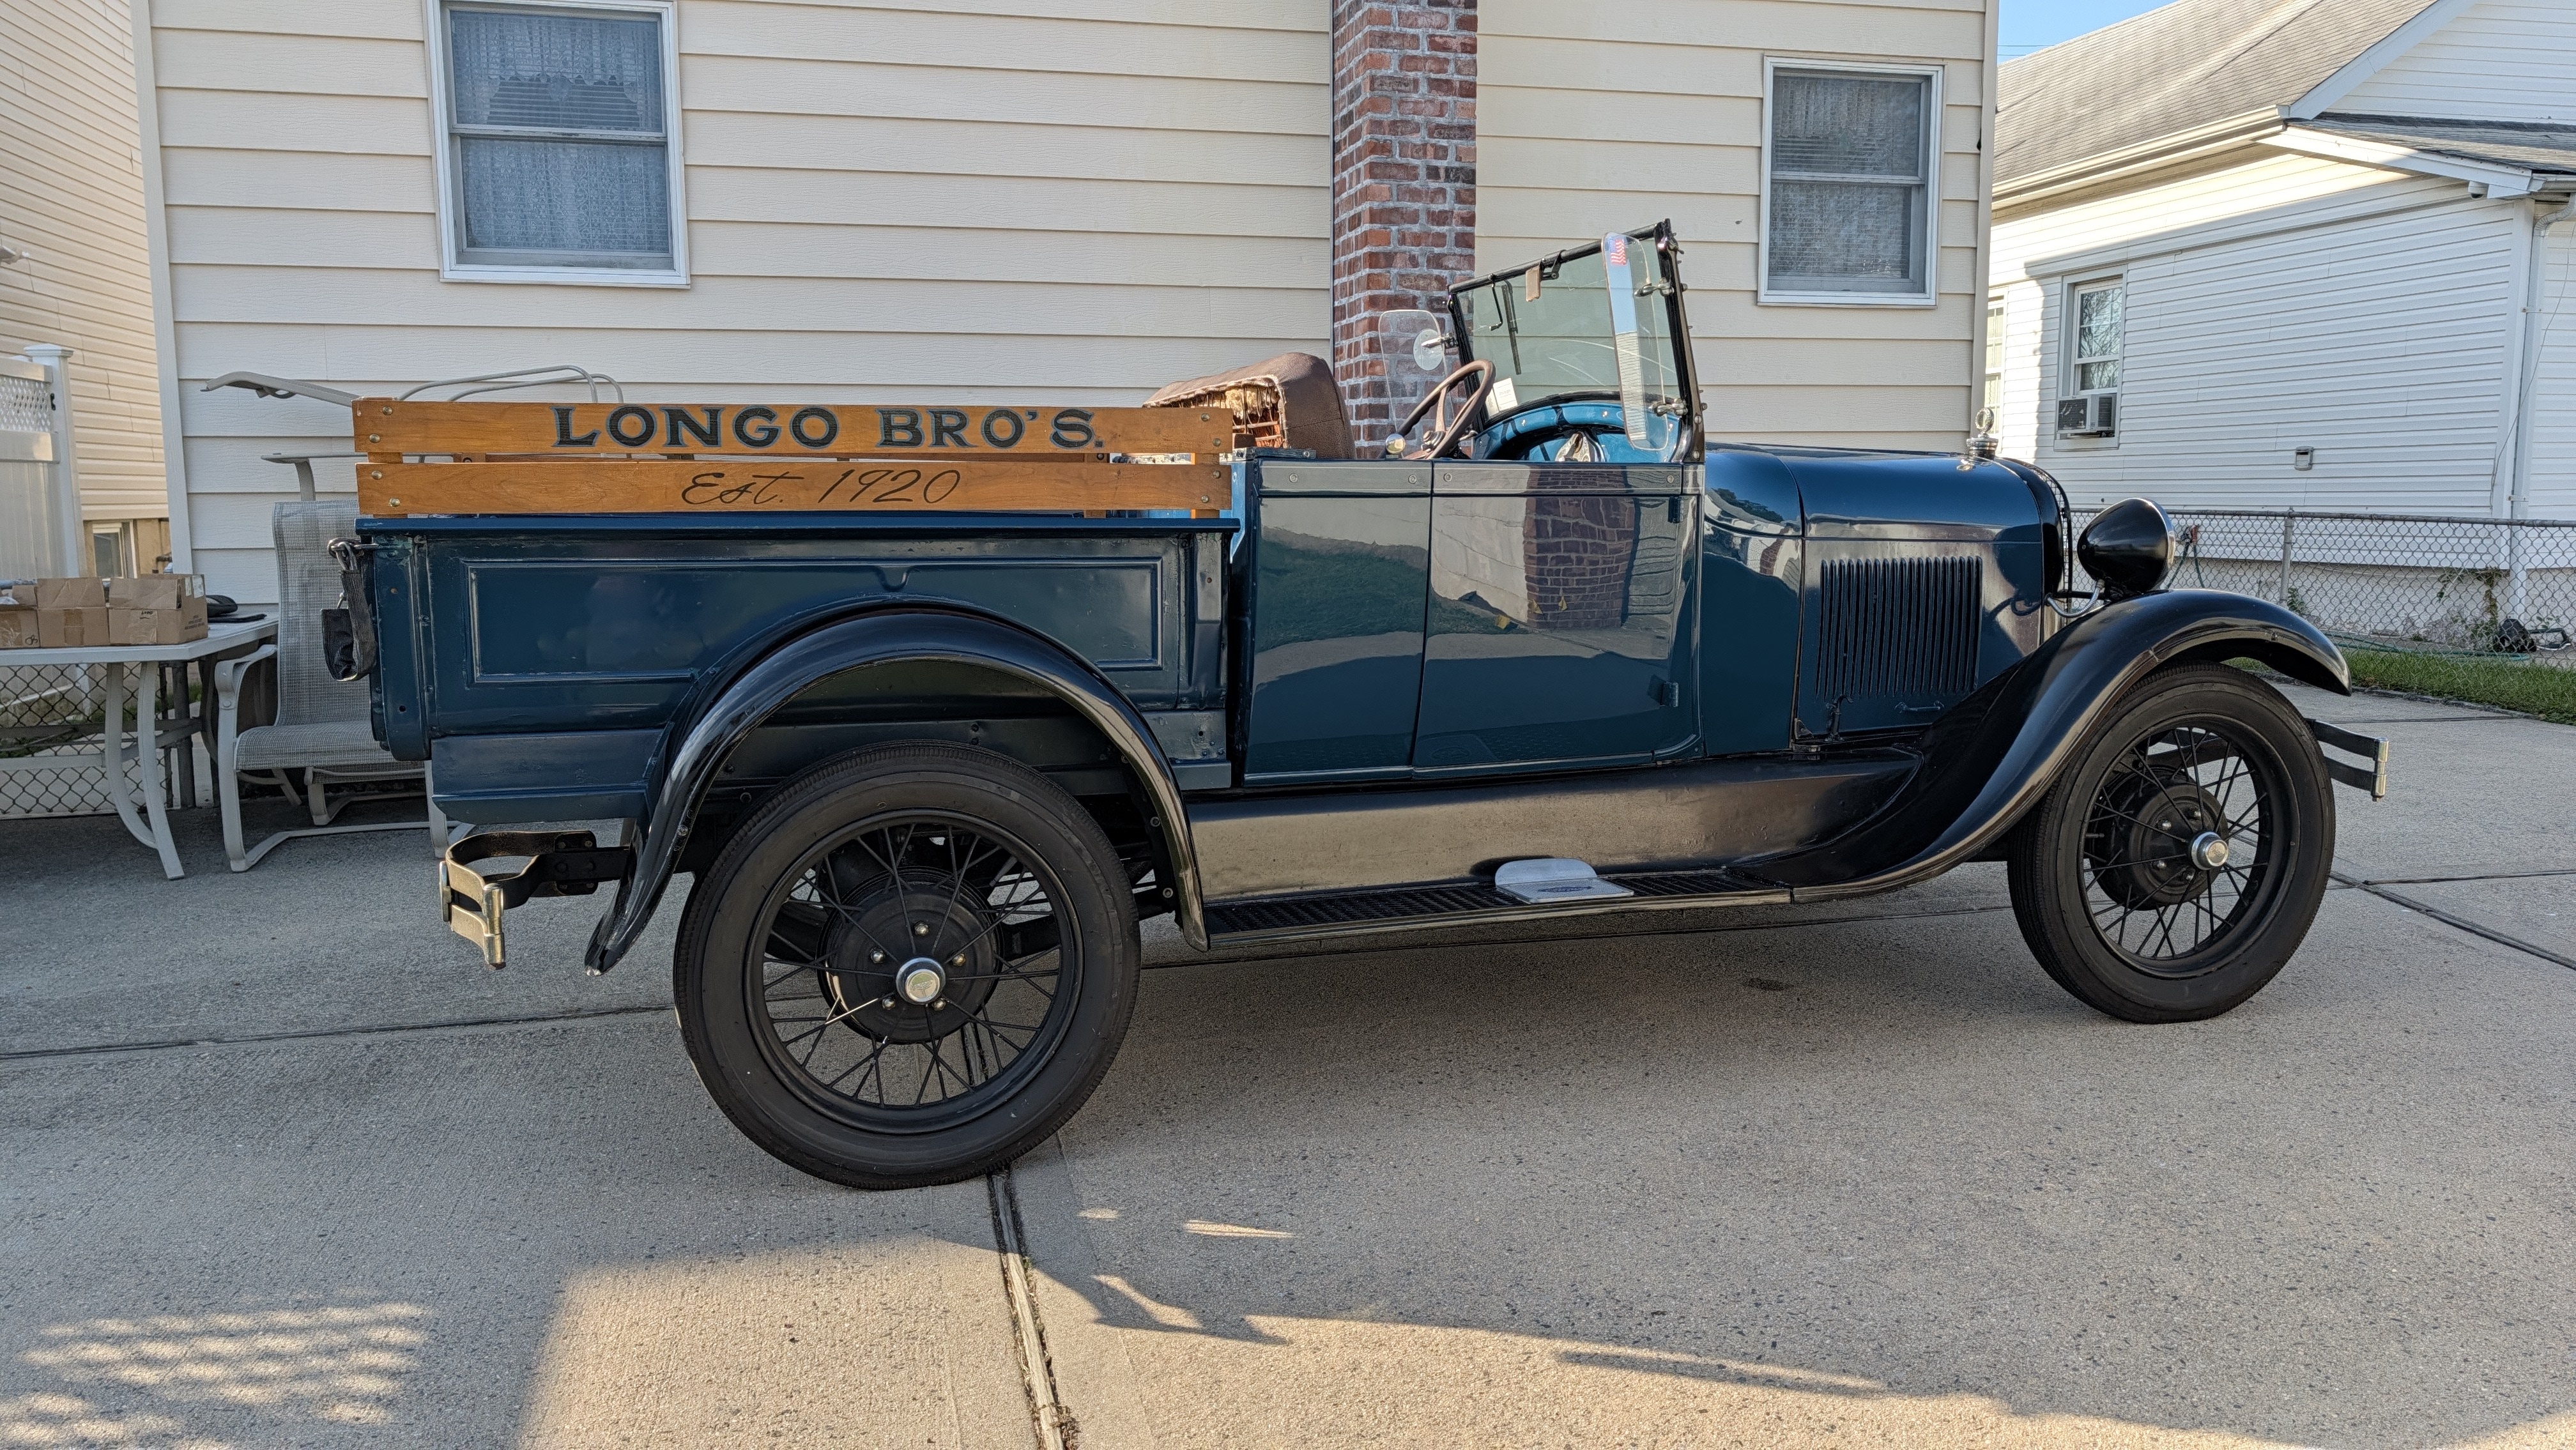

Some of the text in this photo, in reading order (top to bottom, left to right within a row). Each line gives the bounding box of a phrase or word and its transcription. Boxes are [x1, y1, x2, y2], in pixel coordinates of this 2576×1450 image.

[549, 405, 1104, 448] LONGO BRO'S.
[681, 469, 961, 504] Est. 1920
